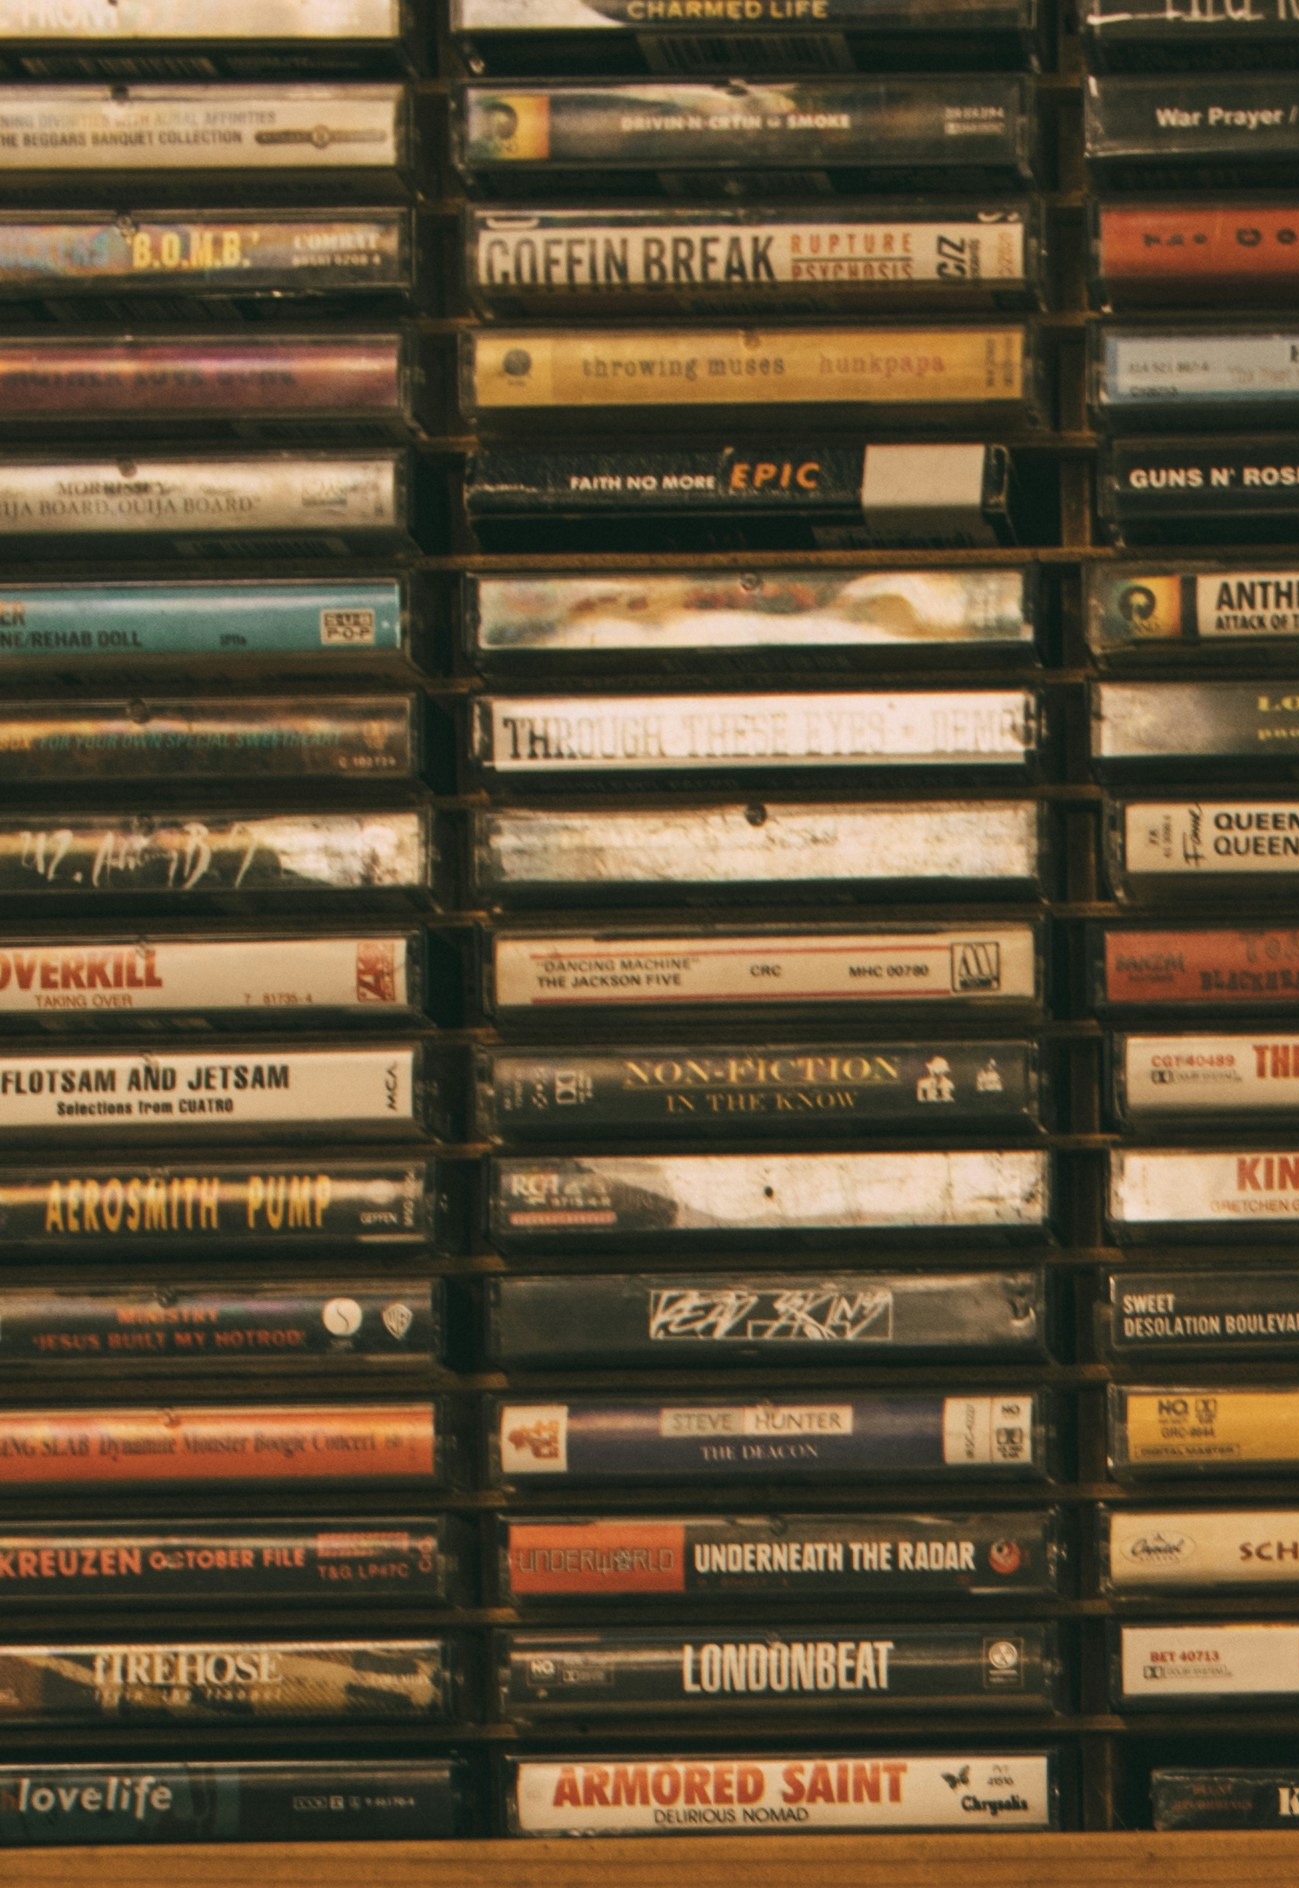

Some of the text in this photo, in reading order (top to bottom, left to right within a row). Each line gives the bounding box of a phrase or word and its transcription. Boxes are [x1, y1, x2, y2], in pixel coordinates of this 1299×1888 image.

[1156, 107, 1201, 128] War
[1208, 103, 1284, 132] Prayer
[570, 461, 821, 491] FAITH NO MORE EPIC
[1129, 468, 1204, 488] GUNS
[1211, 468, 1238, 487] N'
[1216, 615, 1268, 630] ATTACK
[1272, 615, 1289, 629] OF
[1214, 836, 1299, 856] QUEEN
[58, 1098, 234, 1116] Selections from CUATRO
[682, 1641, 894, 1692] LONDONBEAT
[554, 1762, 908, 1806] ARMORED SAINT
[654, 1806, 809, 1824] DELIRIOUS NOMAD
